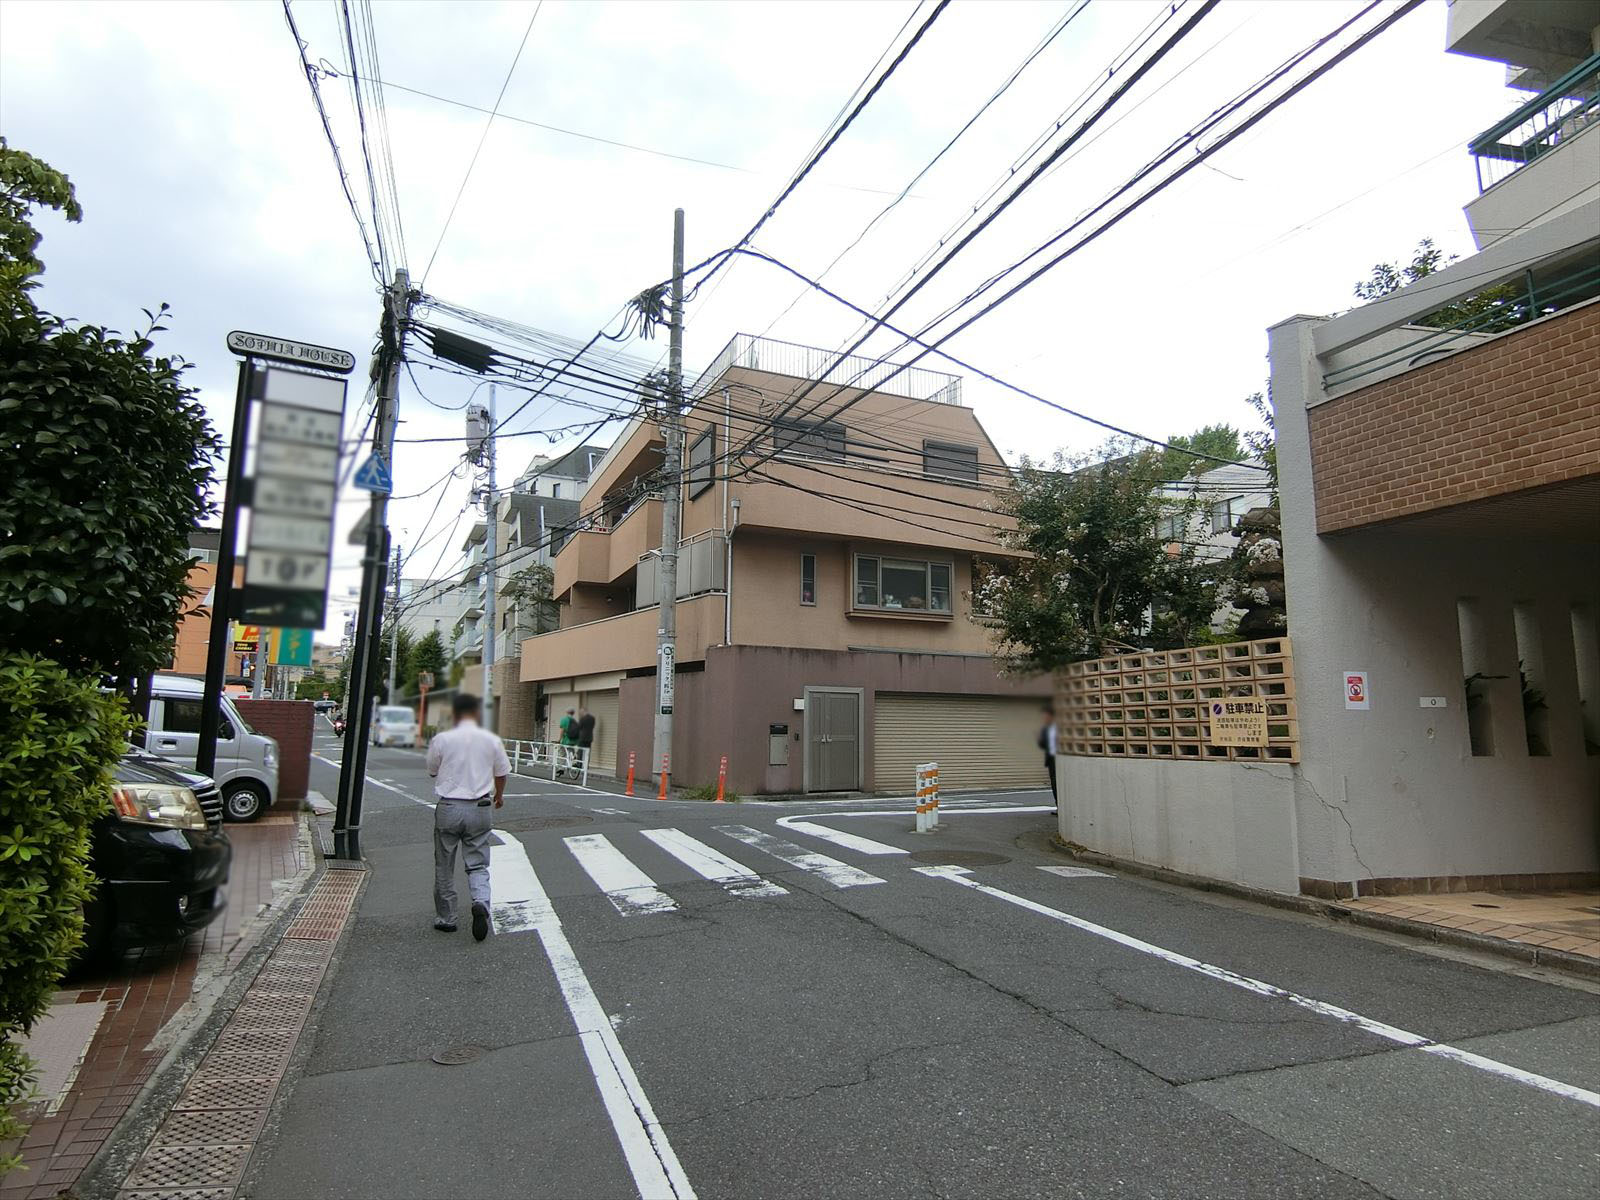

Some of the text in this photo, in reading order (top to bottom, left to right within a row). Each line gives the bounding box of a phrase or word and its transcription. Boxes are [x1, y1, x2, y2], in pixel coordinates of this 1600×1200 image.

[234, 334, 350, 367] SOPHIA HOUSE
[1225, 702, 1264, 714] 駐車禁止
